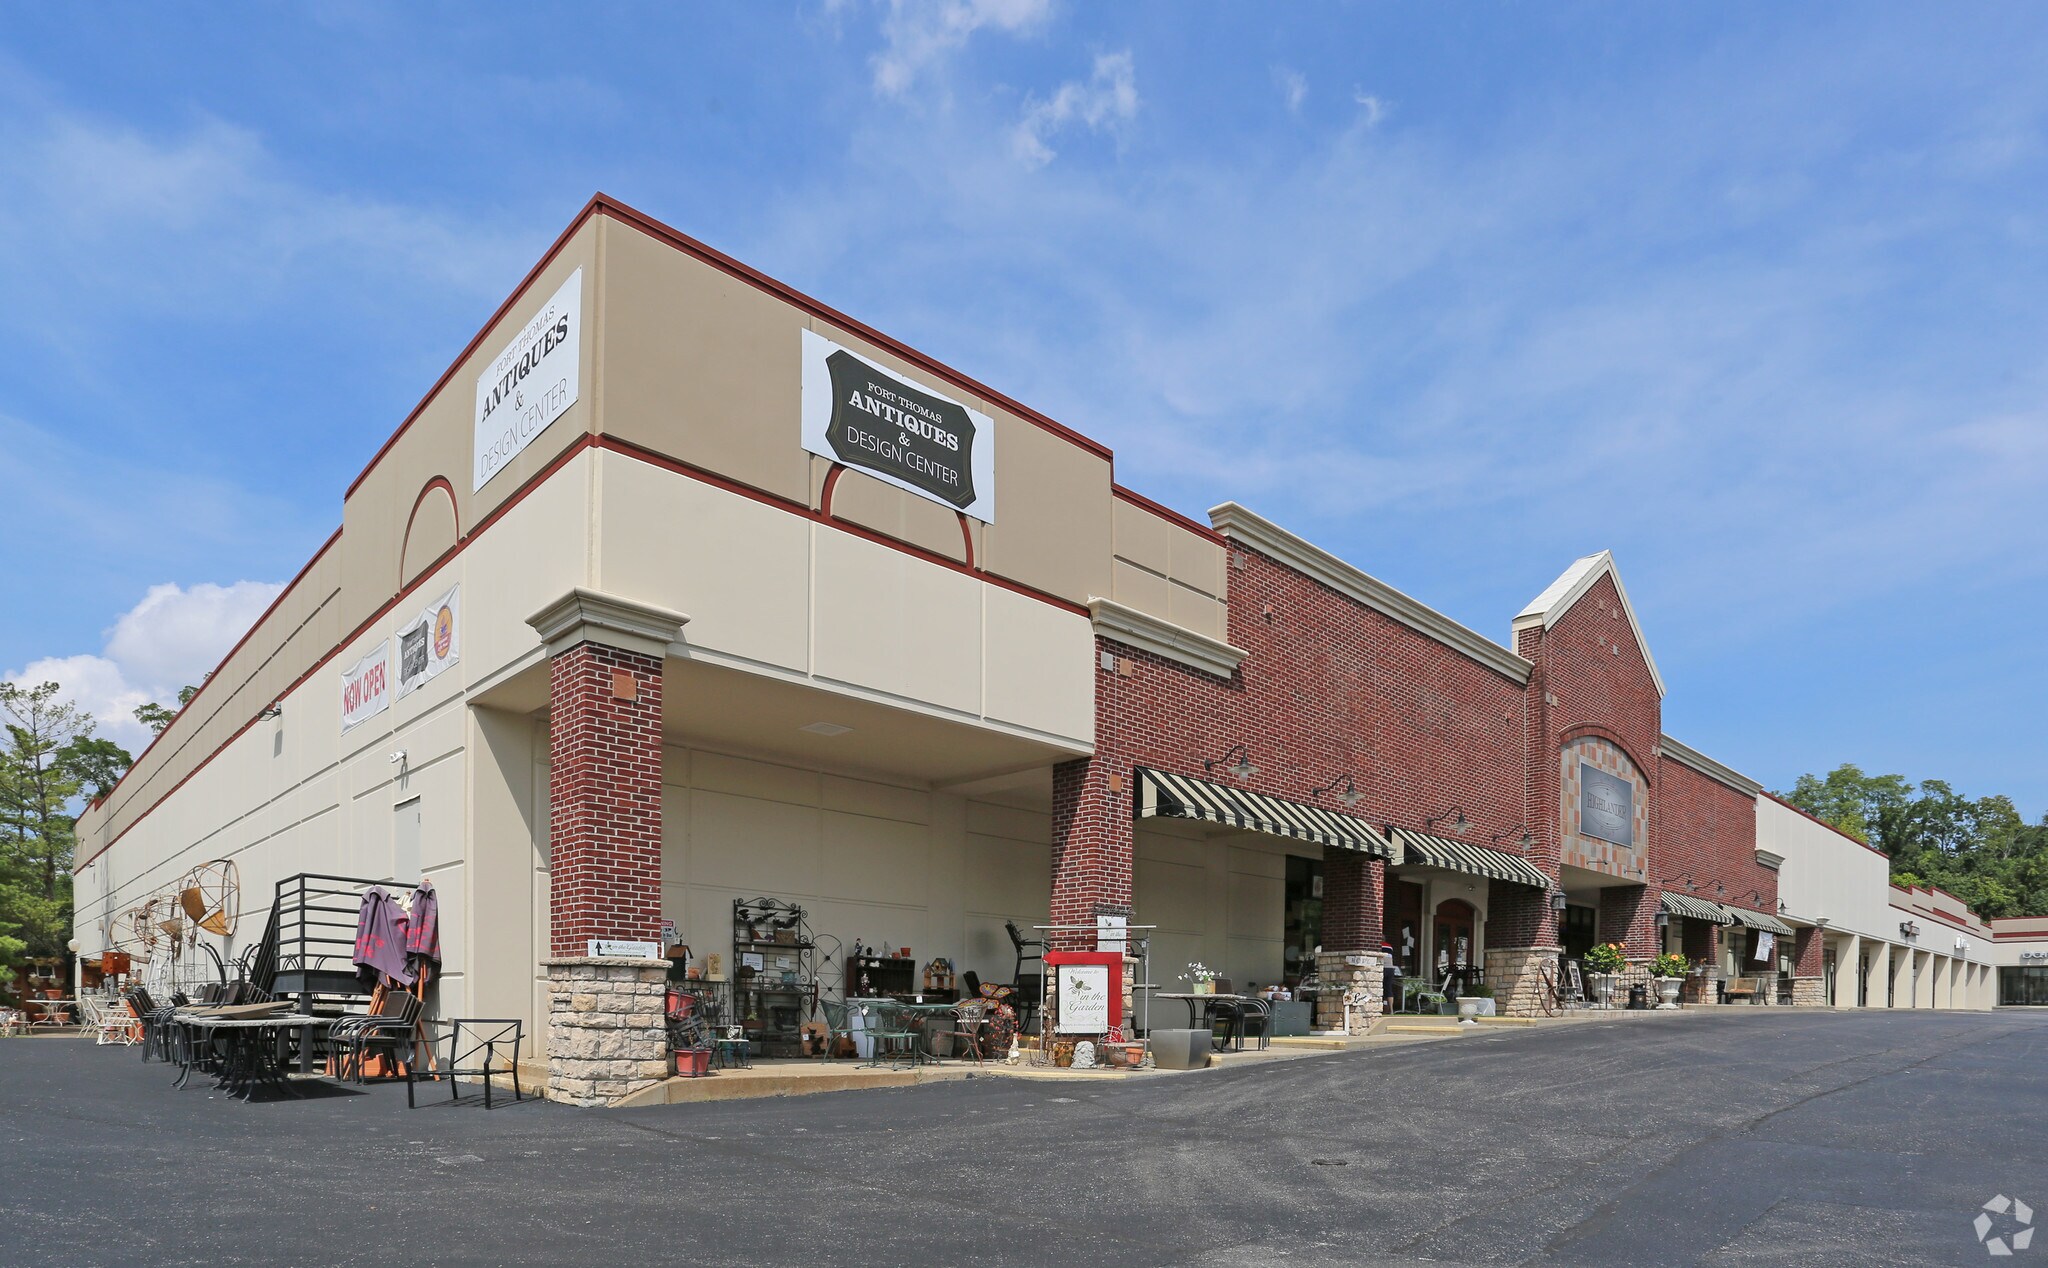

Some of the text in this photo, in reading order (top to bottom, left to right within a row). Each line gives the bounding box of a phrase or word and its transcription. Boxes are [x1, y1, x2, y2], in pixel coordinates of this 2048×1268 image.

[496, 305, 555, 378] FORT THOMAS
[481, 312, 568, 423] ANTIQUES
[514, 390, 524, 412] &
[848, 389, 959, 451] ANTIQUES
[867, 381, 942, 424] FORT THOMAS
[480, 377, 568, 479] DESIGN CENTER
[898, 432, 911, 447] &
[847, 425, 958, 487] DESIGN CENTER
[344, 676, 361, 716] NOW
[364, 659, 386, 704] OPEN
[1587, 792, 1626, 819] HIGHLANDER
[1069, 1000, 1105, 1014] Garden
[1090, 992, 1104, 1001] the
